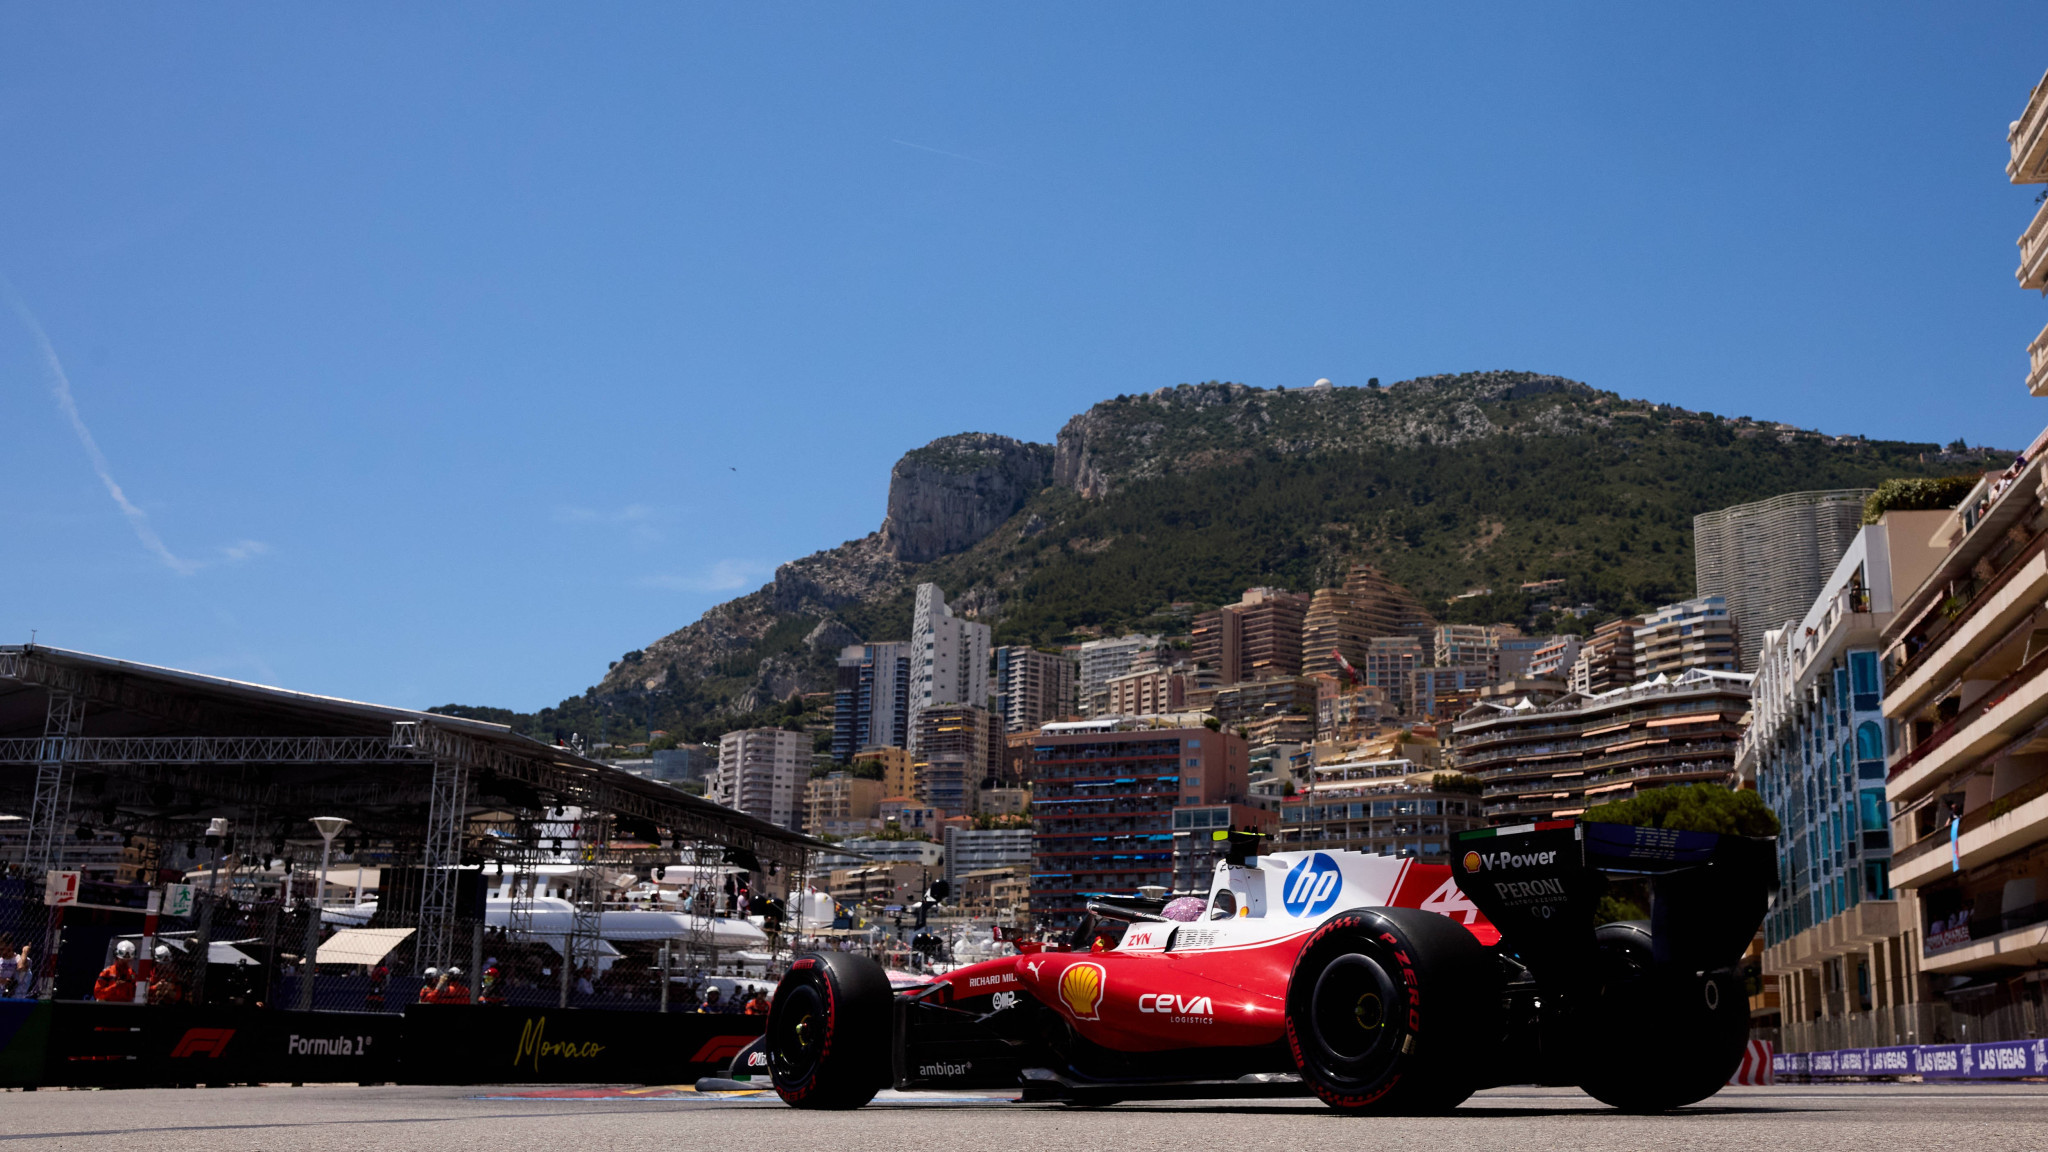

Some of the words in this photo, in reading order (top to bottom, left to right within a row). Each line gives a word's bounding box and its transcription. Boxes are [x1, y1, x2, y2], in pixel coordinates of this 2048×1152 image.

[1481, 850, 1558, 871] V-Power
[1286, 852, 1340, 918] hp
[1494, 877, 1566, 900] PERONI
[1128, 932, 1152, 947] ZYN
[969, 975, 1000, 988] RICHARD
[1379, 932, 1397, 944] P
[1394, 949, 1420, 1032] ZERO
[1138, 993, 1214, 1015] CEVA
[1170, 1016, 1213, 1025] LOGISTICS
[288, 1034, 353, 1056] Formula
[513, 1016, 606, 1073] Monaco
[919, 1061, 966, 1077] ambipar
[1883, 1051, 1908, 1069] VEGAS
[1920, 1052, 1933, 1072] LAS
[1932, 1050, 1958, 1071] VEGAS
[1979, 1049, 1996, 1070] LAS
[1995, 1047, 2026, 1070] VEGAS
